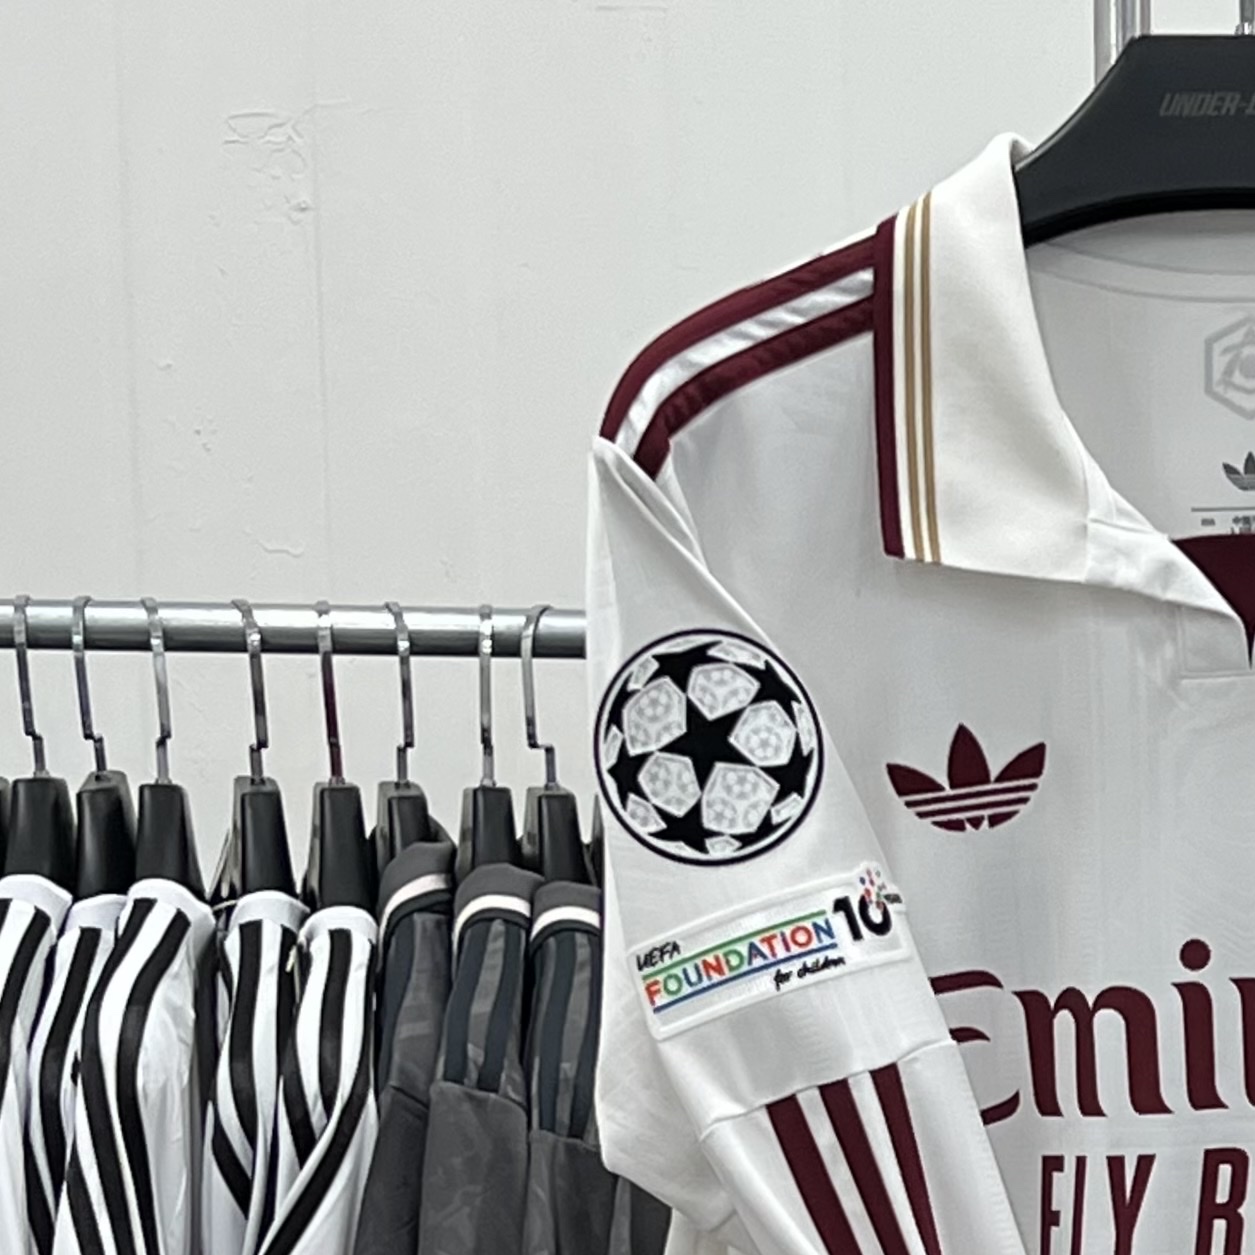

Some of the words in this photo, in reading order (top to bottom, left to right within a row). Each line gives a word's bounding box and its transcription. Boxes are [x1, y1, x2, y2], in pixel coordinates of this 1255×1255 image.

[636, 941, 681, 972] UEFA
[644, 917, 836, 1007] FOUNDATION
[773, 967, 793, 992] for
[796, 954, 846, 979] children
